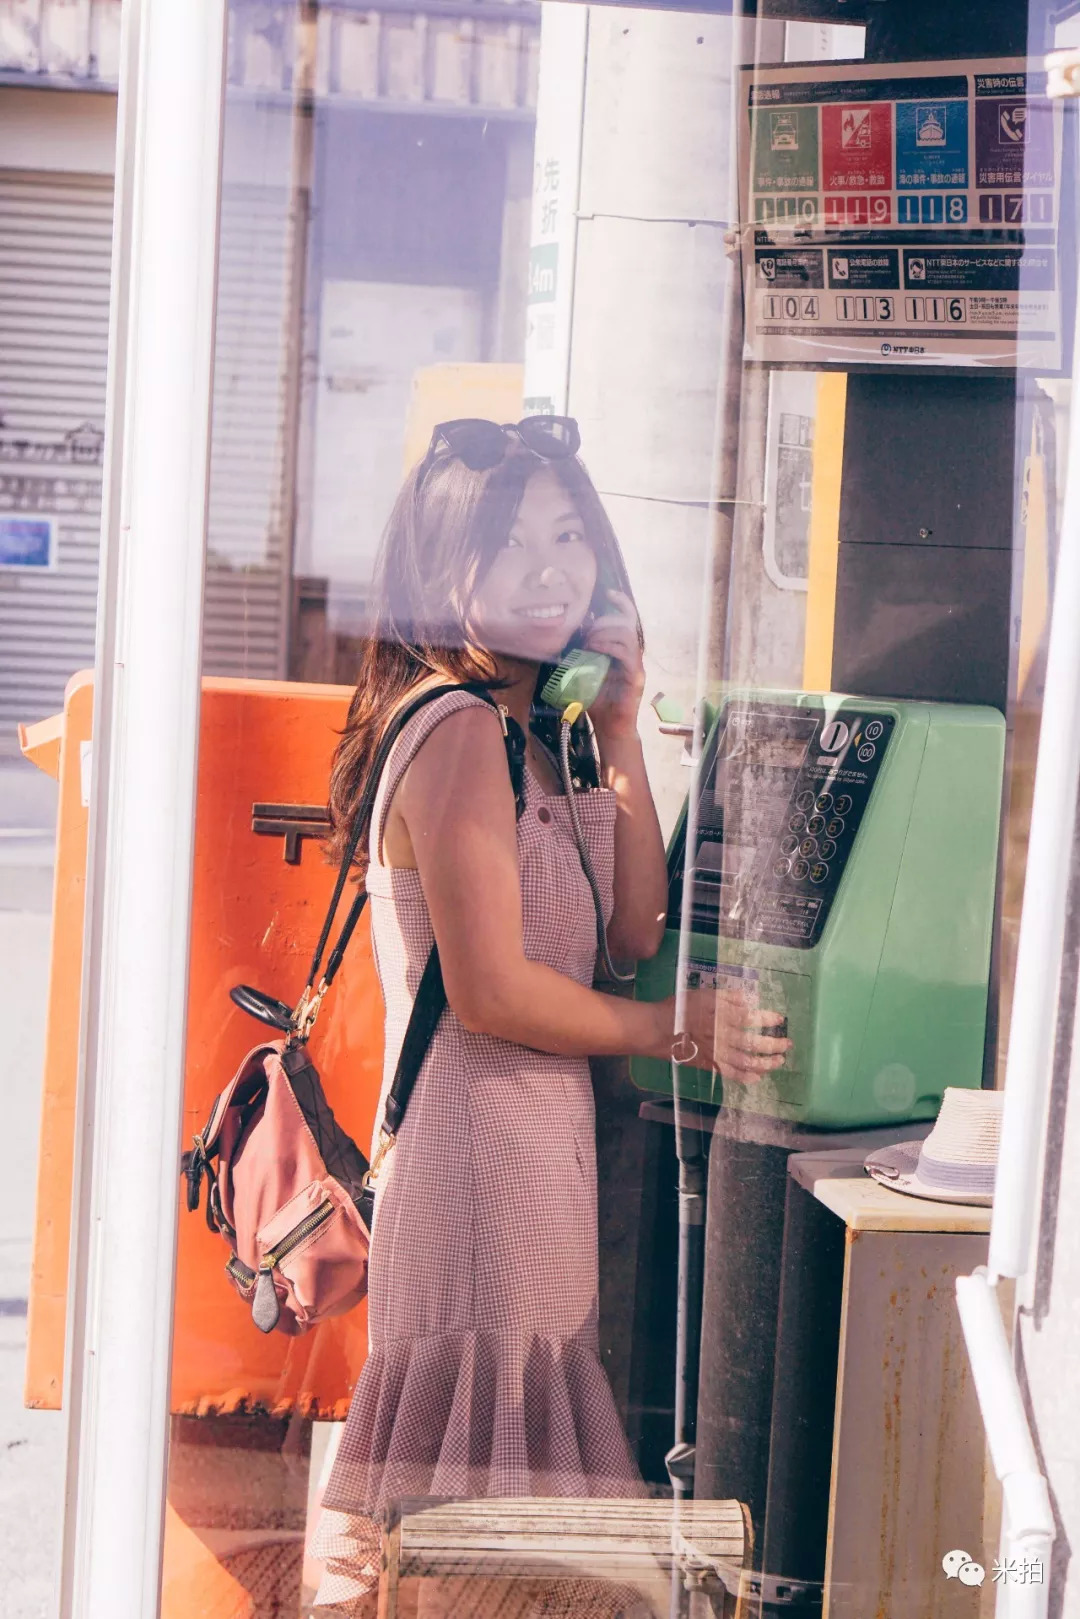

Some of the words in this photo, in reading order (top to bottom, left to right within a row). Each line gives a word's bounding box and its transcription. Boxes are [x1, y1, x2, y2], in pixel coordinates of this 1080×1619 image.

[762, 199, 815, 223] 110
[832, 198, 888, 222] 119
[906, 197, 964, 221] 118
[988, 197, 1045, 220] 171
[770, 297, 817, 318] 104
[843, 298, 891, 320] 113
[912, 298, 963, 321] 116
[868, 726, 879, 735] 10
[860, 748, 873, 758] 100
